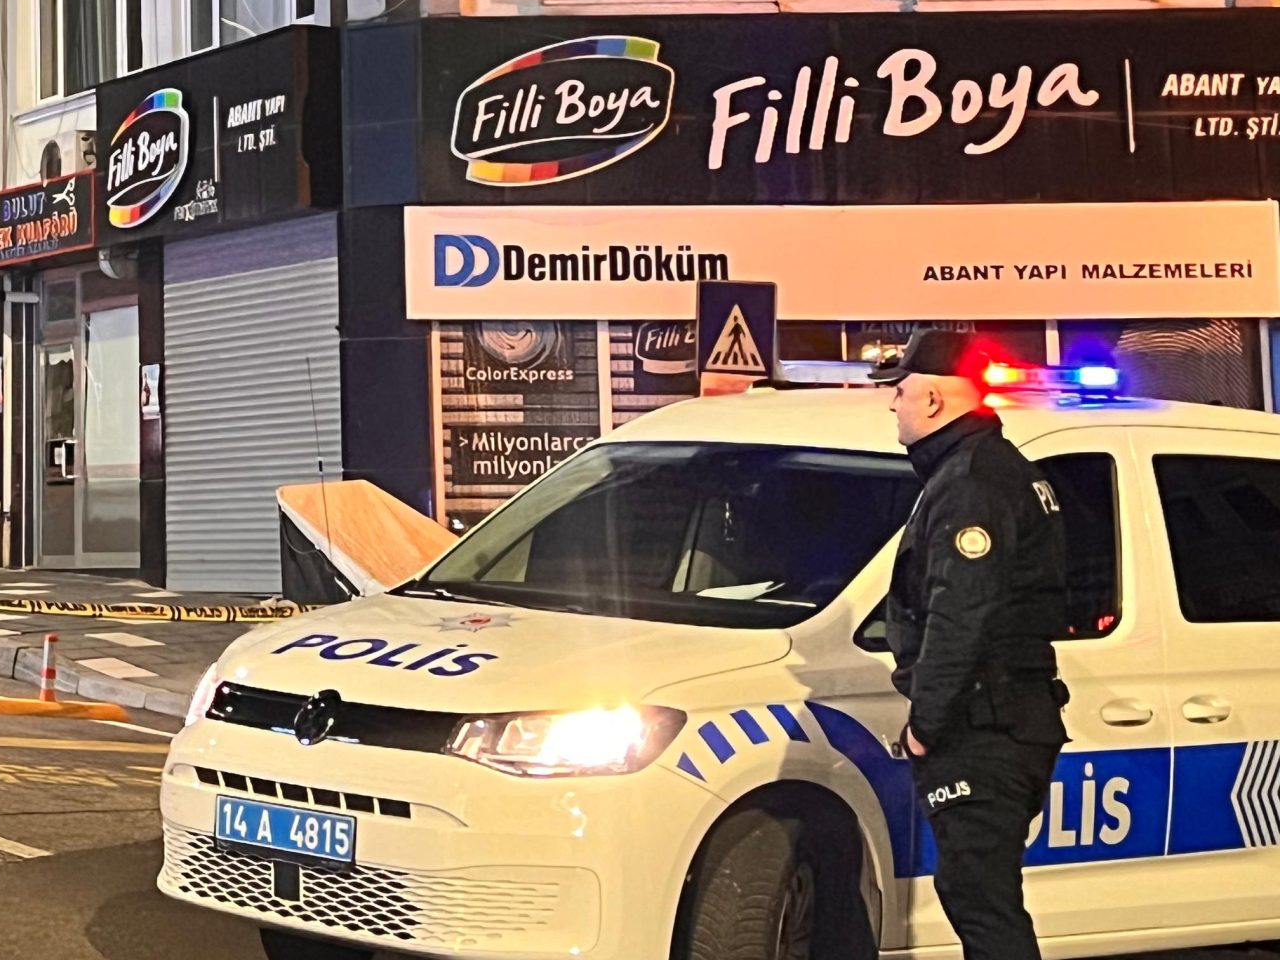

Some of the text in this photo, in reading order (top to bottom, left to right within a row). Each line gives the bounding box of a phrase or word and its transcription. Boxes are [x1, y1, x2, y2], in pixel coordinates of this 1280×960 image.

[1161, 73, 1245, 97] ABANT
[227, 99, 263, 128] ABANT
[472, 79, 660, 142] Filli Boya
[708, 48, 1100, 170] Filli Boya
[1194, 117, 1239, 137] LTD.
[107, 131, 178, 191] Filli Boya
[503, 244, 729, 281] DemirDöküm
[923, 259, 1253, 281] ABANT YAPI MALZEMELERİ
[466, 366, 574, 382] ColorExpress
[271, 634, 499, 677] POLİS
[223, 802, 350, 856] 14 A 4815
